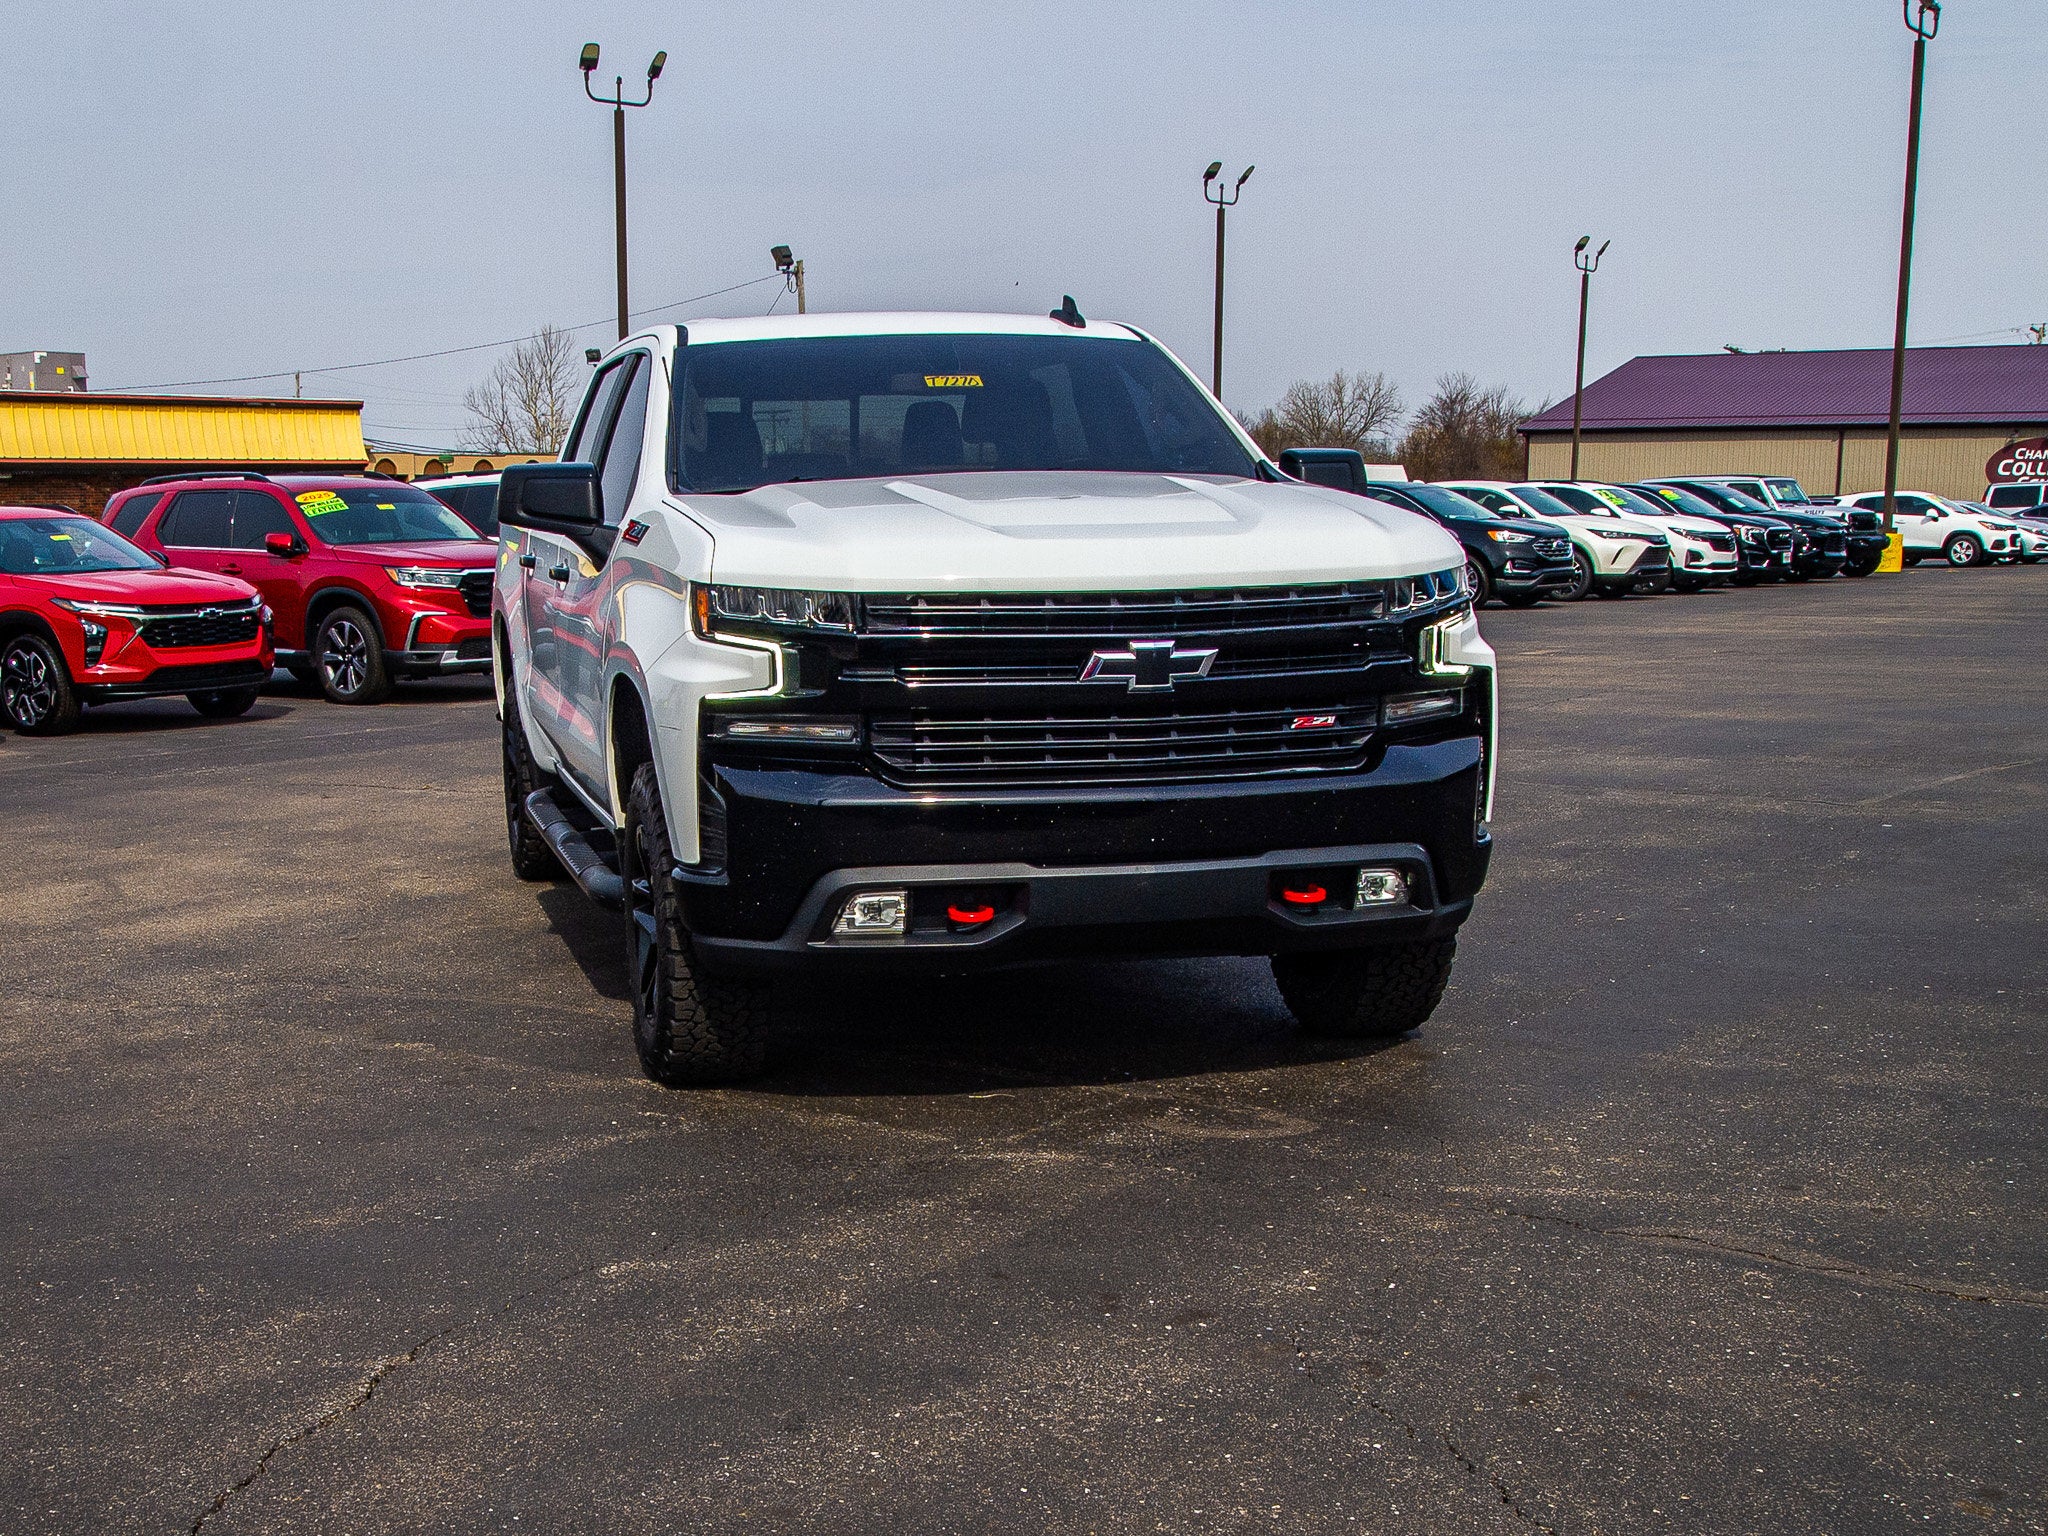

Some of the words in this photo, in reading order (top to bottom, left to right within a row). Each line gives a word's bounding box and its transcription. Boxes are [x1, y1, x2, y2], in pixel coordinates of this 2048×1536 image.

[1997, 459, 2048, 476] COLL
[306, 503, 346, 515] LEATHER
[1291, 716, 1336, 729] Z71
